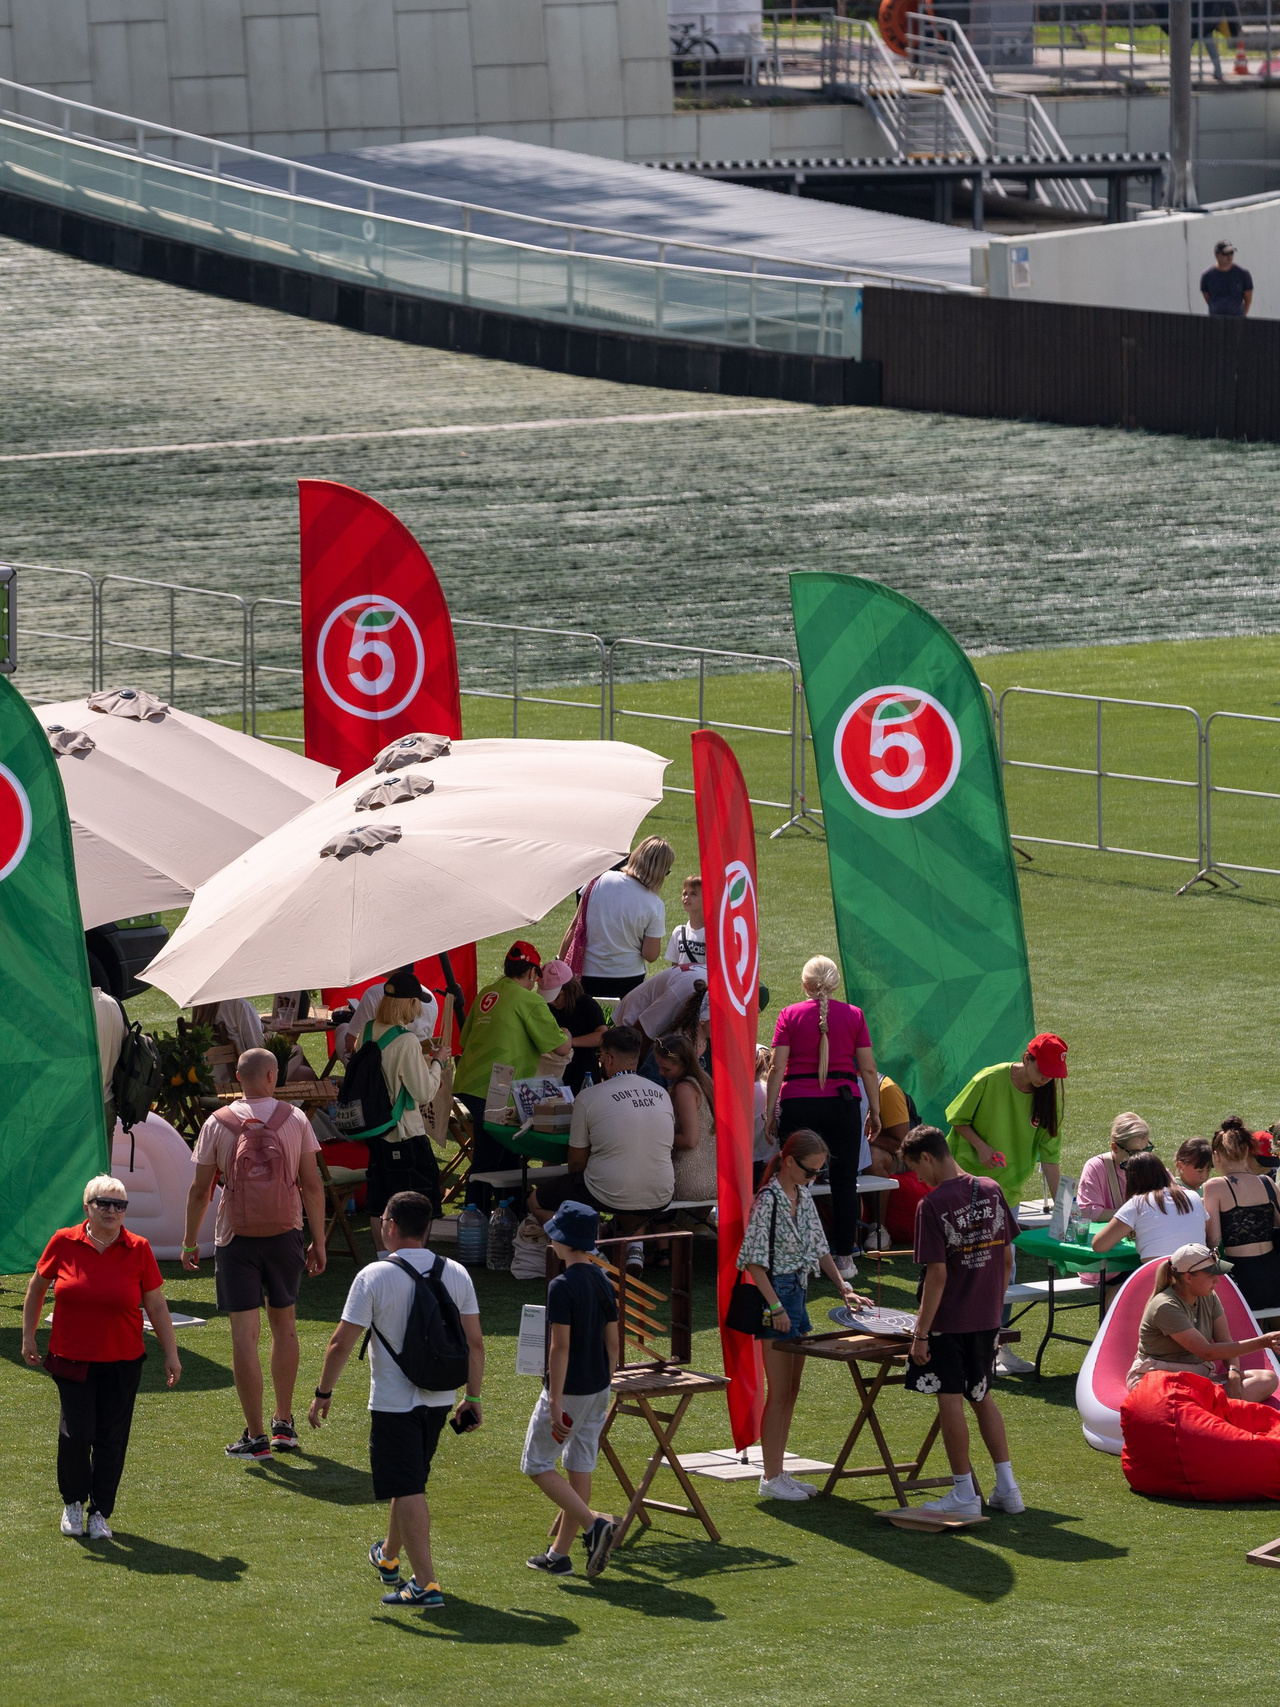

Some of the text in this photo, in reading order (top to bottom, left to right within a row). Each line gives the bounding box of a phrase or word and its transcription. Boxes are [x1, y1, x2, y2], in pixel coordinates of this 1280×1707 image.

[347, 604, 400, 696] 5
[870, 694, 929, 793] 5
[679, 941, 705, 955] adas
[611, 1088, 664, 1102] DON'T LOOK
[631, 1098, 656, 1108] BACK
